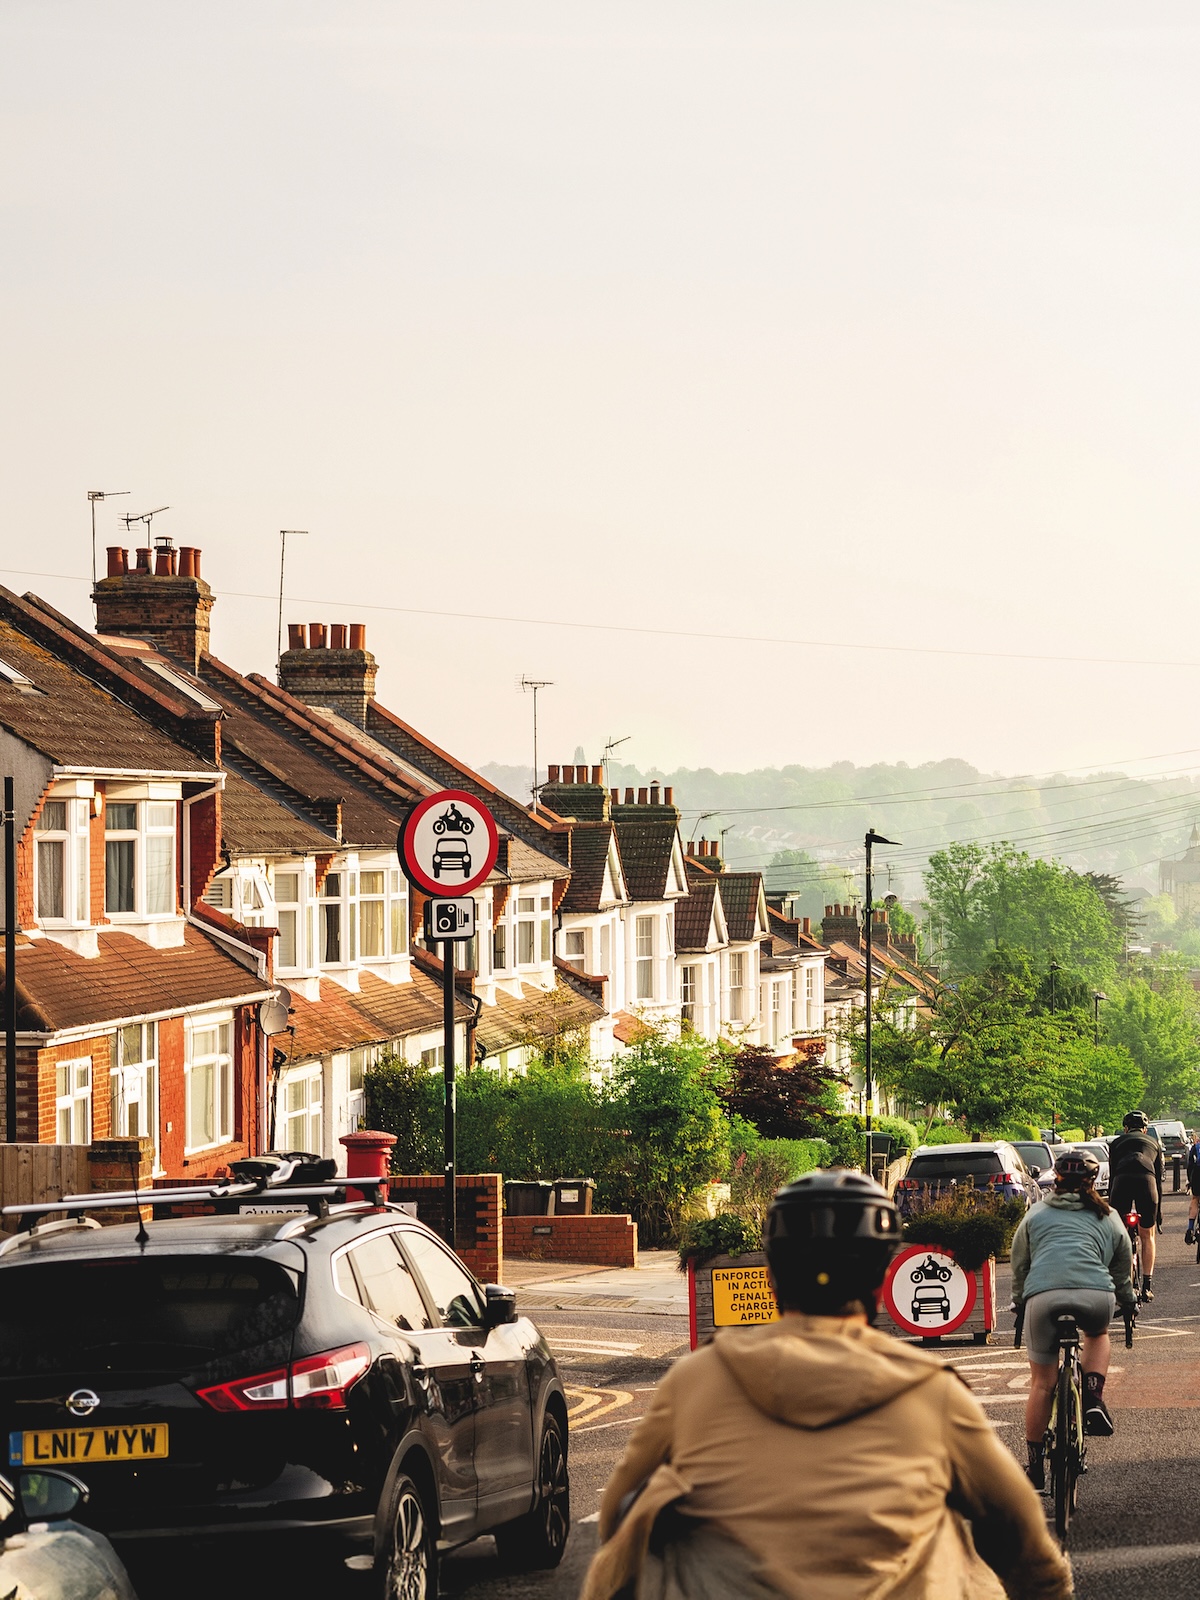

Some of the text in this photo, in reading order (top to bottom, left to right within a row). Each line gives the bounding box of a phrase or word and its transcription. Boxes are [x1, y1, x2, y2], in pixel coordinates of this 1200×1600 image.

[728, 1280, 774, 1291] IN ACTIO
[732, 1291, 773, 1301] PENALT
[740, 1311, 773, 1321] APPLY
[33, 1427, 157, 1460] LN17 WYW
